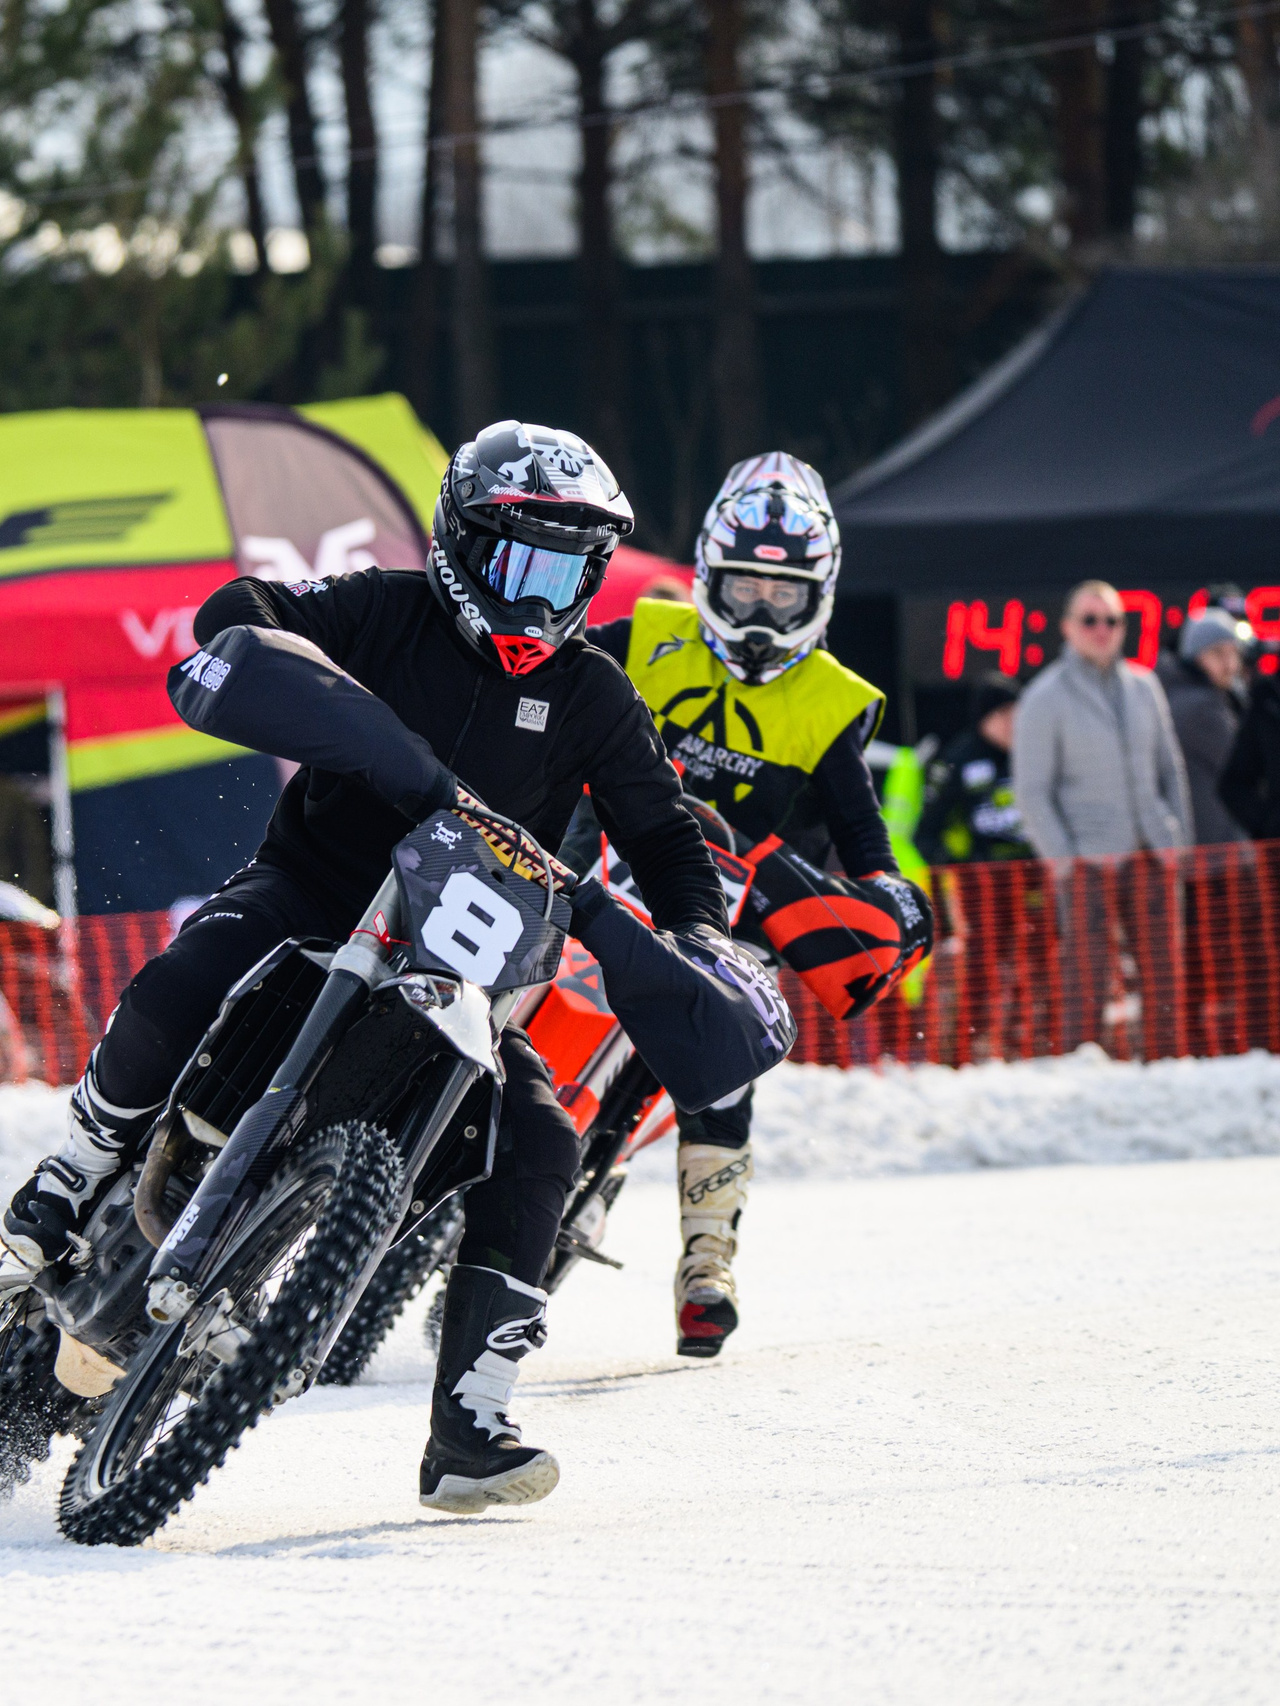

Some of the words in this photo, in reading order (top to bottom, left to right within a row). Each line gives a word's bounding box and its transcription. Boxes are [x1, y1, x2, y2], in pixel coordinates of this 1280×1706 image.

[520, 701, 547, 715] EA7
[677, 733, 764, 778] ANARCHY
[421, 871, 524, 987] 8
